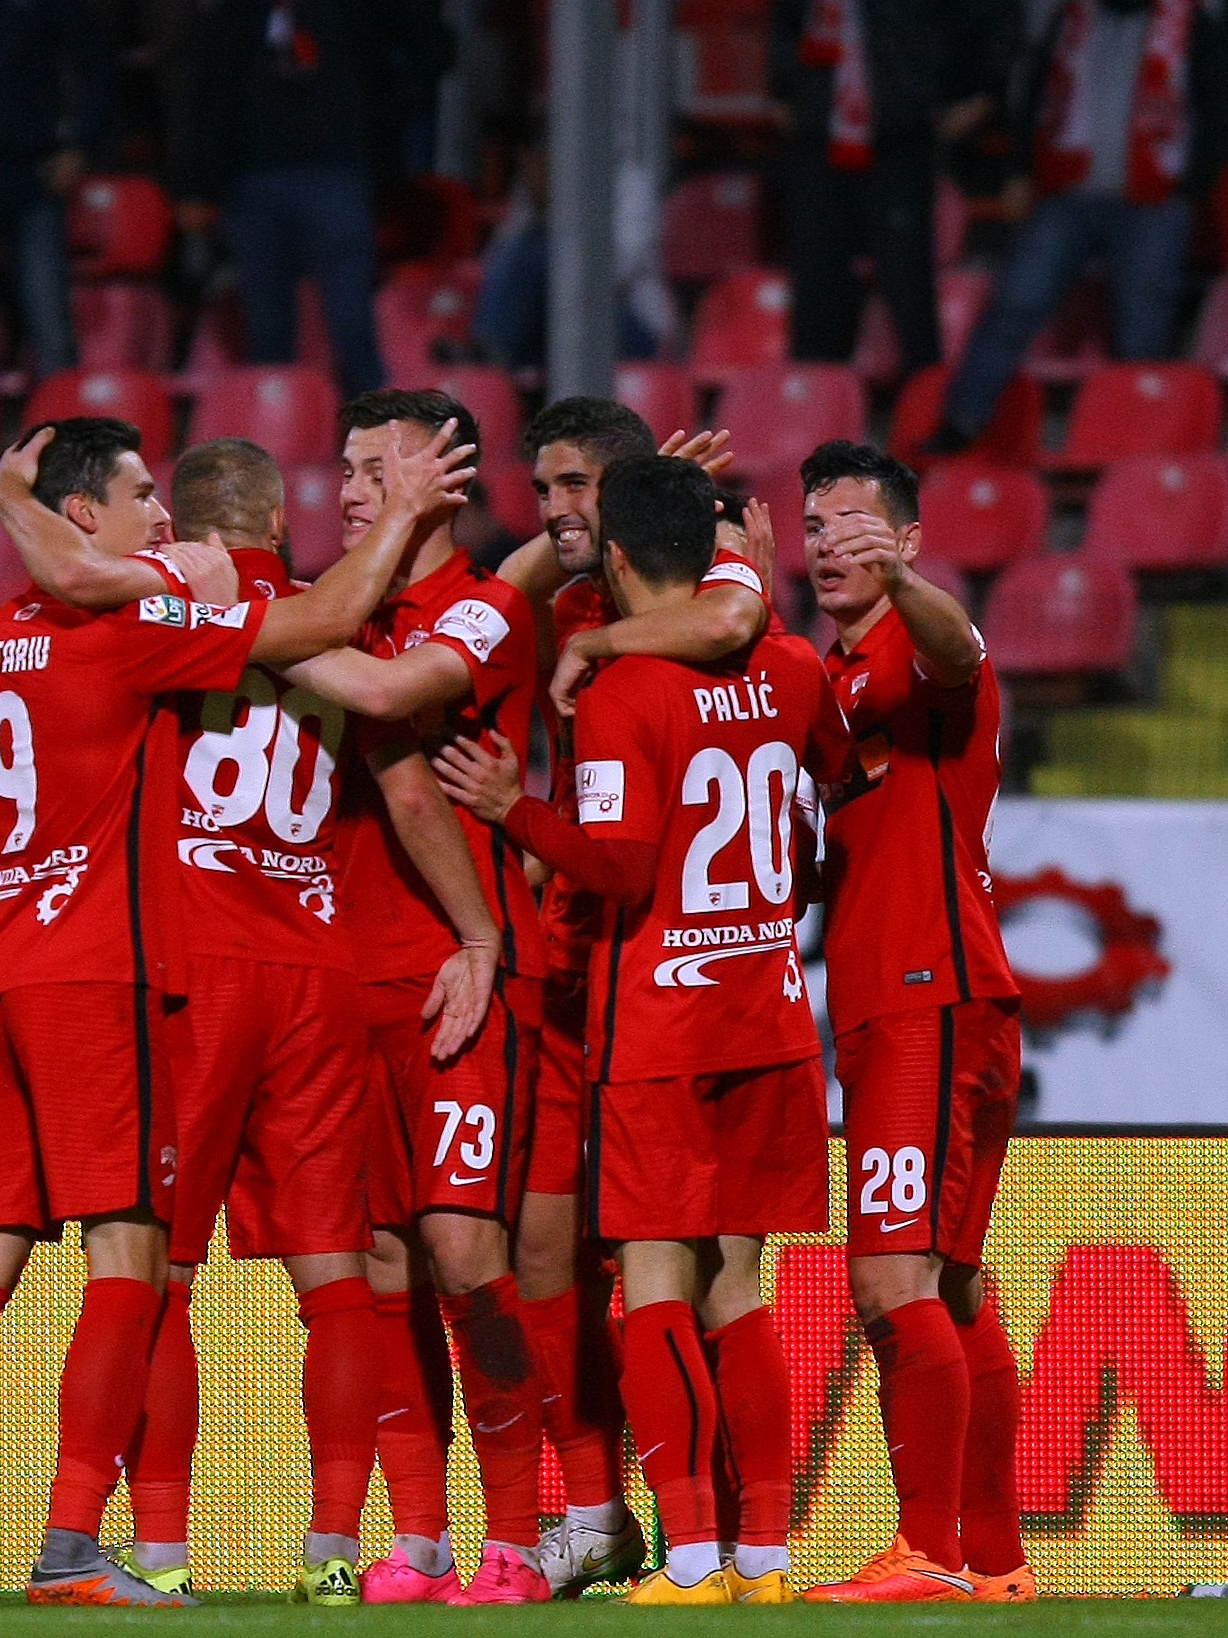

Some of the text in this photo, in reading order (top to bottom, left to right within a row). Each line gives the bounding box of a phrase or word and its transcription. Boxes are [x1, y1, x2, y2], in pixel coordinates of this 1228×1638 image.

[183, 664, 346, 844] 80
[261, 849, 327, 873] NORD
[681, 740, 798, 914] 20
[661, 917, 793, 947] HONDA NOR
[432, 1100, 496, 1170] 73
[860, 1145, 926, 1215] 28
